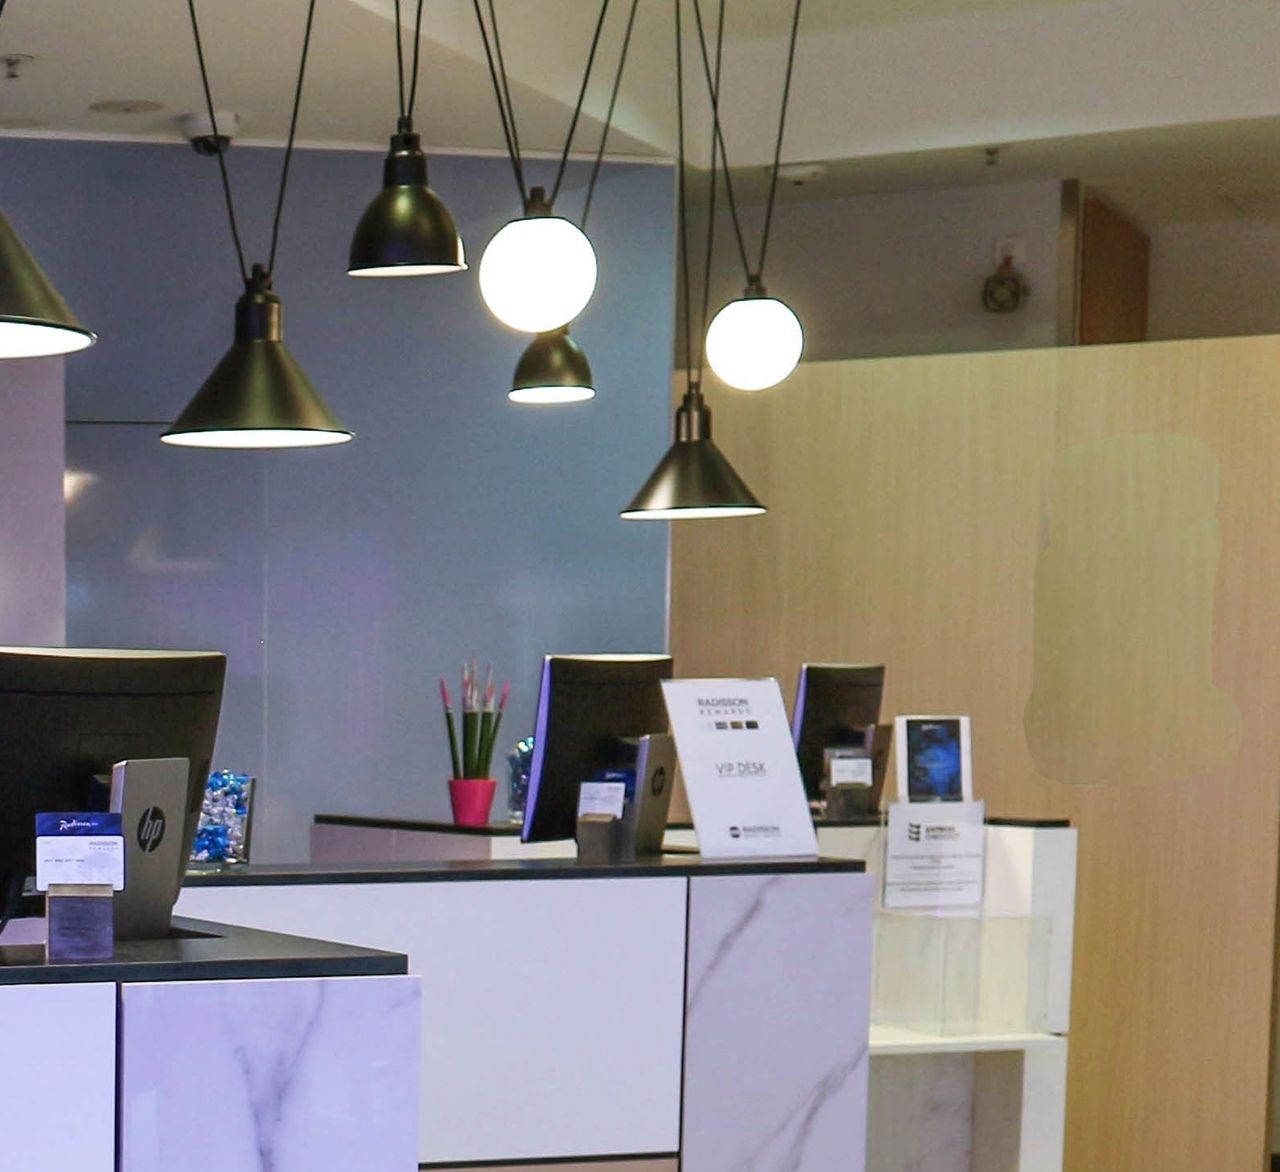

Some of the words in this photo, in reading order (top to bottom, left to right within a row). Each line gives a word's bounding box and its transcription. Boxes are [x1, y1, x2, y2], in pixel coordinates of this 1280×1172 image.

[697, 697, 749, 707] RADISSON
[715, 762, 735, 774] VIP
[737, 760, 767, 776] DESK
[140, 806, 164, 852] hp
